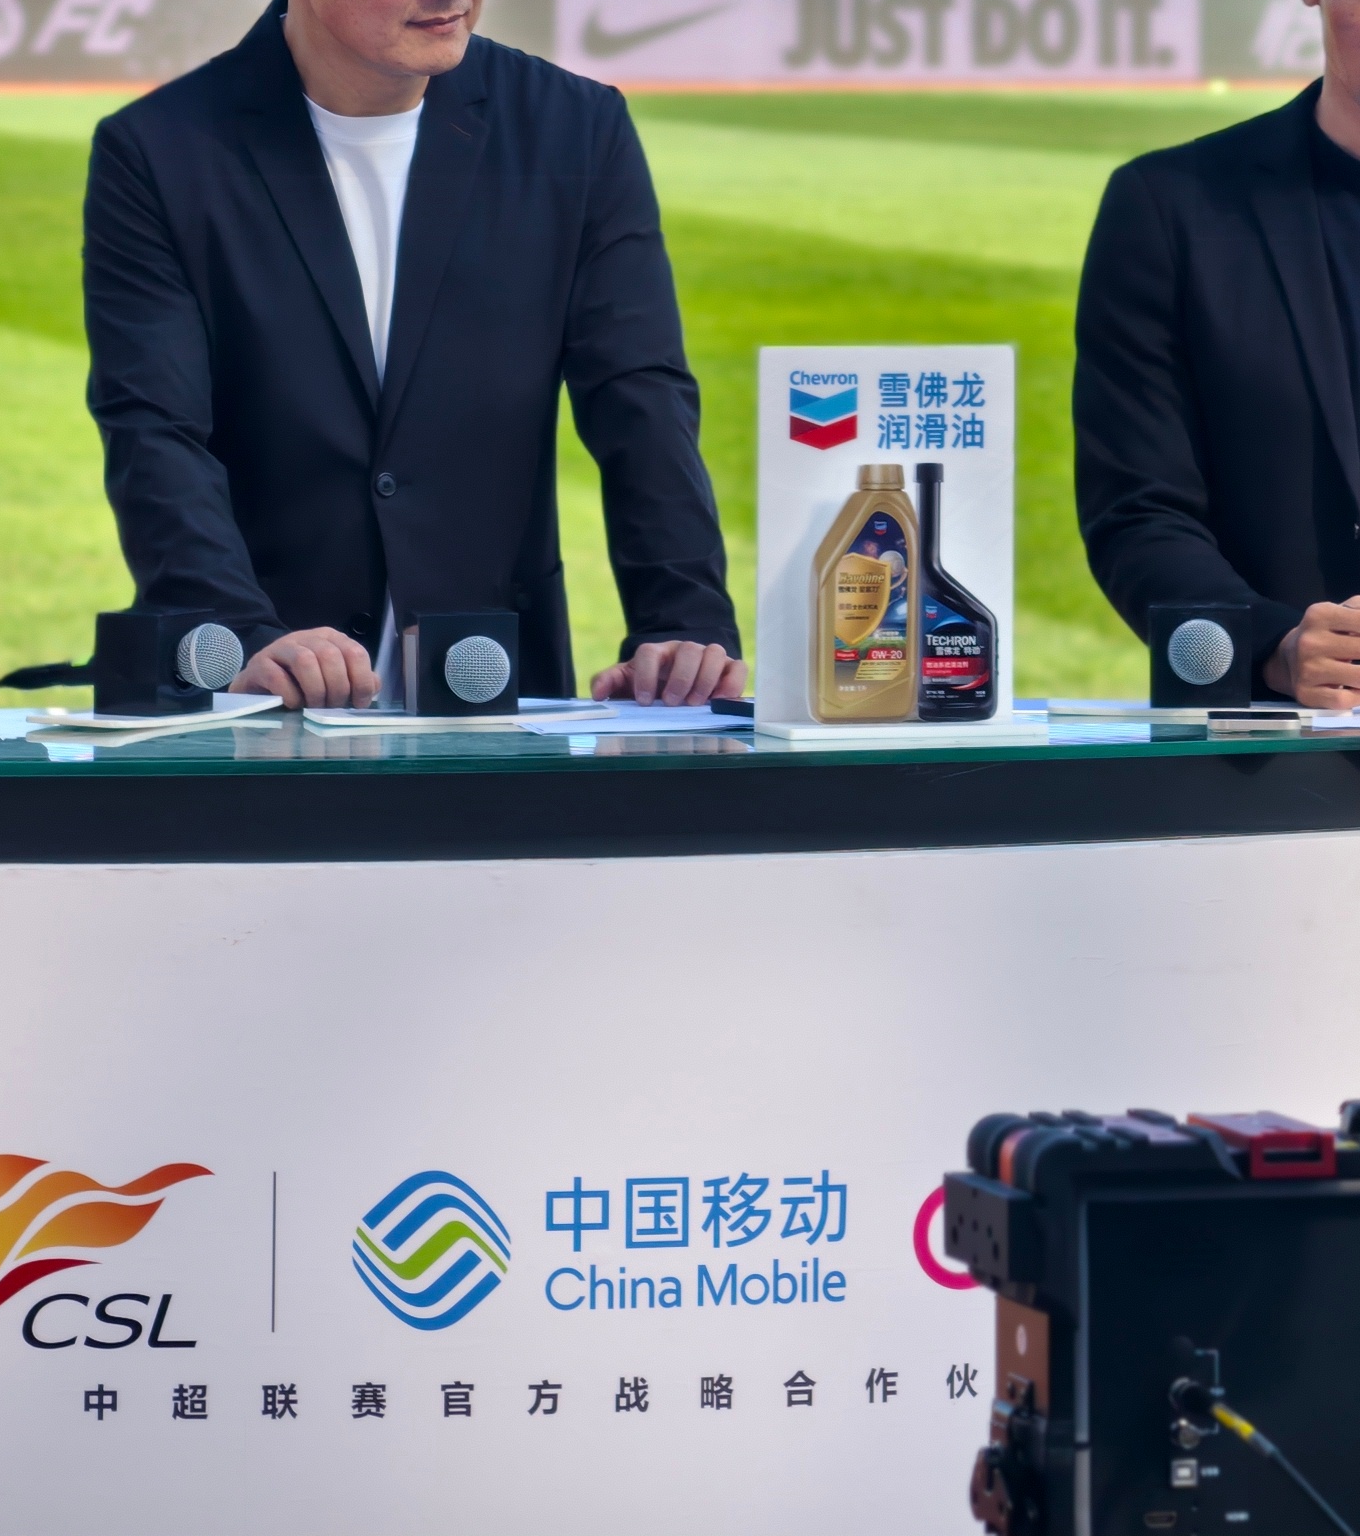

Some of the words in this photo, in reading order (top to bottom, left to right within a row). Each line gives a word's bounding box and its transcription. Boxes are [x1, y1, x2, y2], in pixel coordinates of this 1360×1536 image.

[789, 370, 859, 386] Chevron
[877, 371, 986, 409] 雪佛龙
[877, 413, 986, 450] 润滑油
[871, 650, 903, 659] 0W-20
[925, 634, 977, 648] TECHRON
[544, 1169, 847, 1252] 中国移动
[544, 1264, 682, 1311] China
[696, 1257, 847, 1306] Mobile
[21, 1293, 198, 1350] CSL
[83, 1363, 978, 1421] 中超联赛官方战略合作伙
